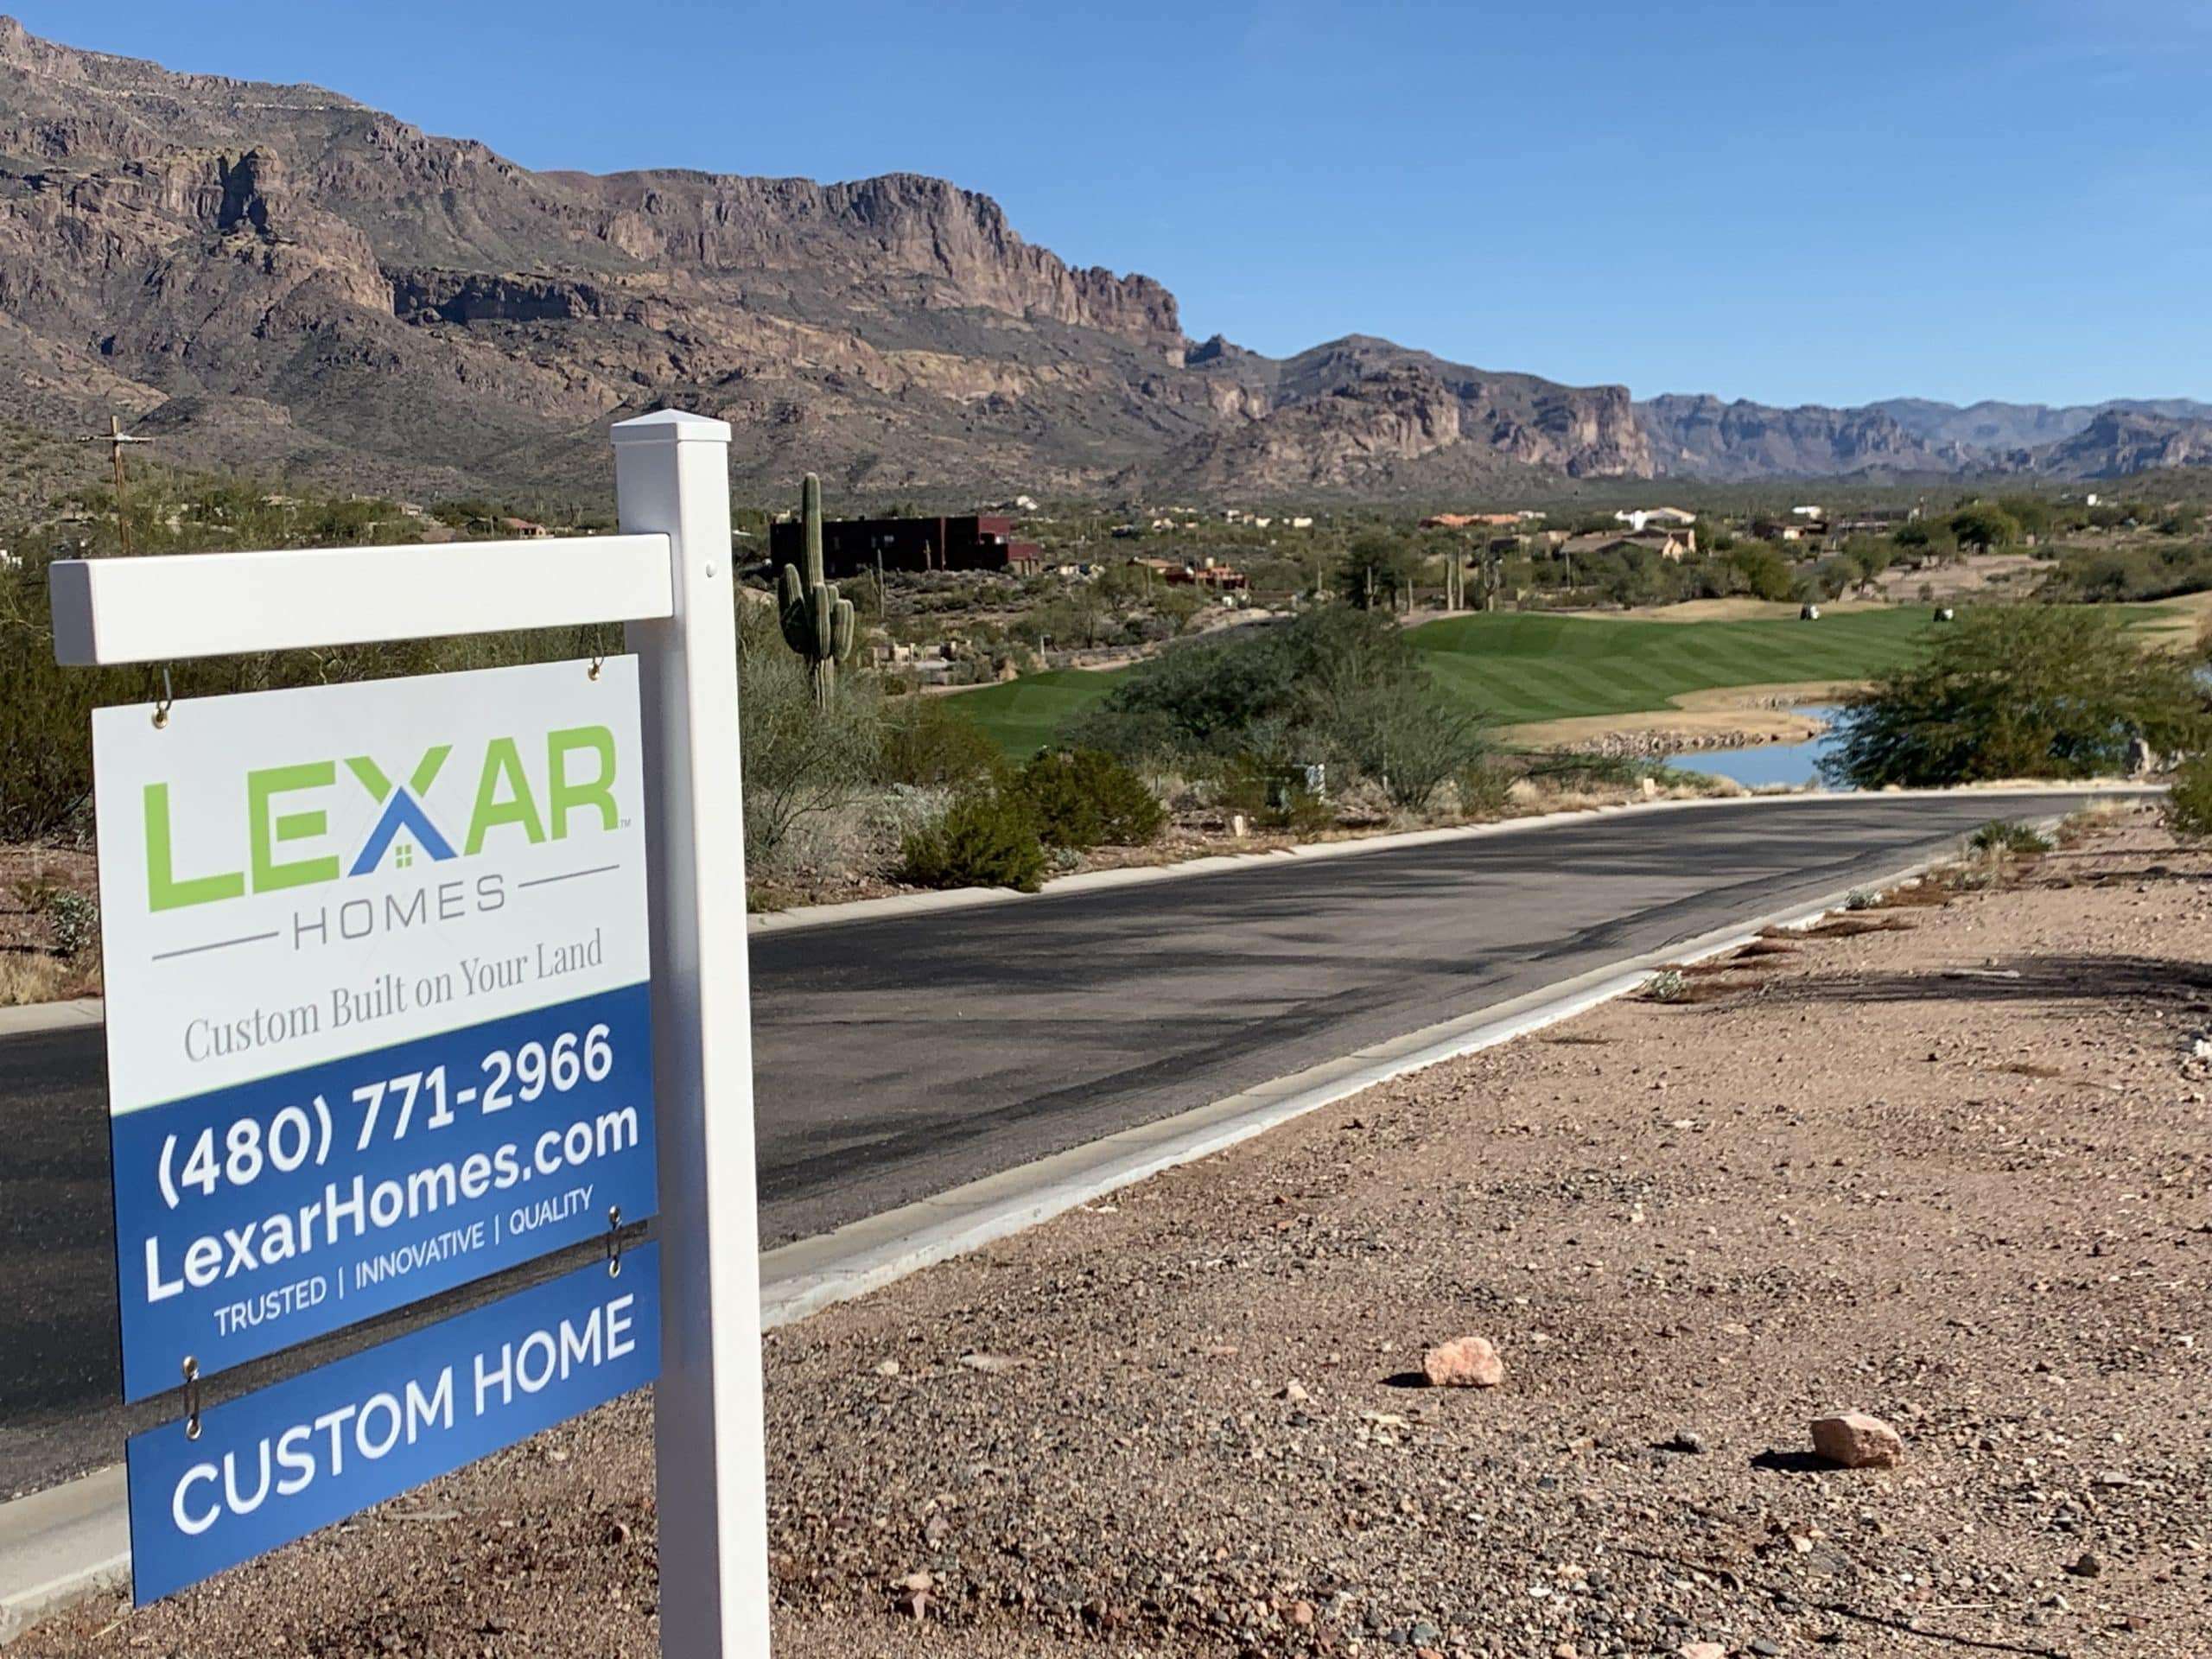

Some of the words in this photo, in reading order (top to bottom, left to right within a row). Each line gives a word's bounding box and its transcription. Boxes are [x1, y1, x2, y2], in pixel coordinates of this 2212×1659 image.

[143, 725, 620, 913] LEXAR
[293, 874, 505, 950] HOMES
[184, 1005, 321, 1064] Custom
[331, 976, 406, 1029] Built
[415, 976, 454, 1007] on
[460, 955, 529, 997] Your
[536, 927, 603, 981] Land
[144, 1105, 639, 1303] LexarHomes.com
[157, 1095, 331, 1210] (480)
[352, 1022, 614, 1152] 771-2966
[213, 1277, 327, 1338] TRUSTED
[354, 1220, 485, 1290] INNOVATIVE
[509, 1185, 594, 1236] QUALITY
[171, 1364, 454, 1535] CUSTOM
[473, 1294, 636, 1415] HOME
